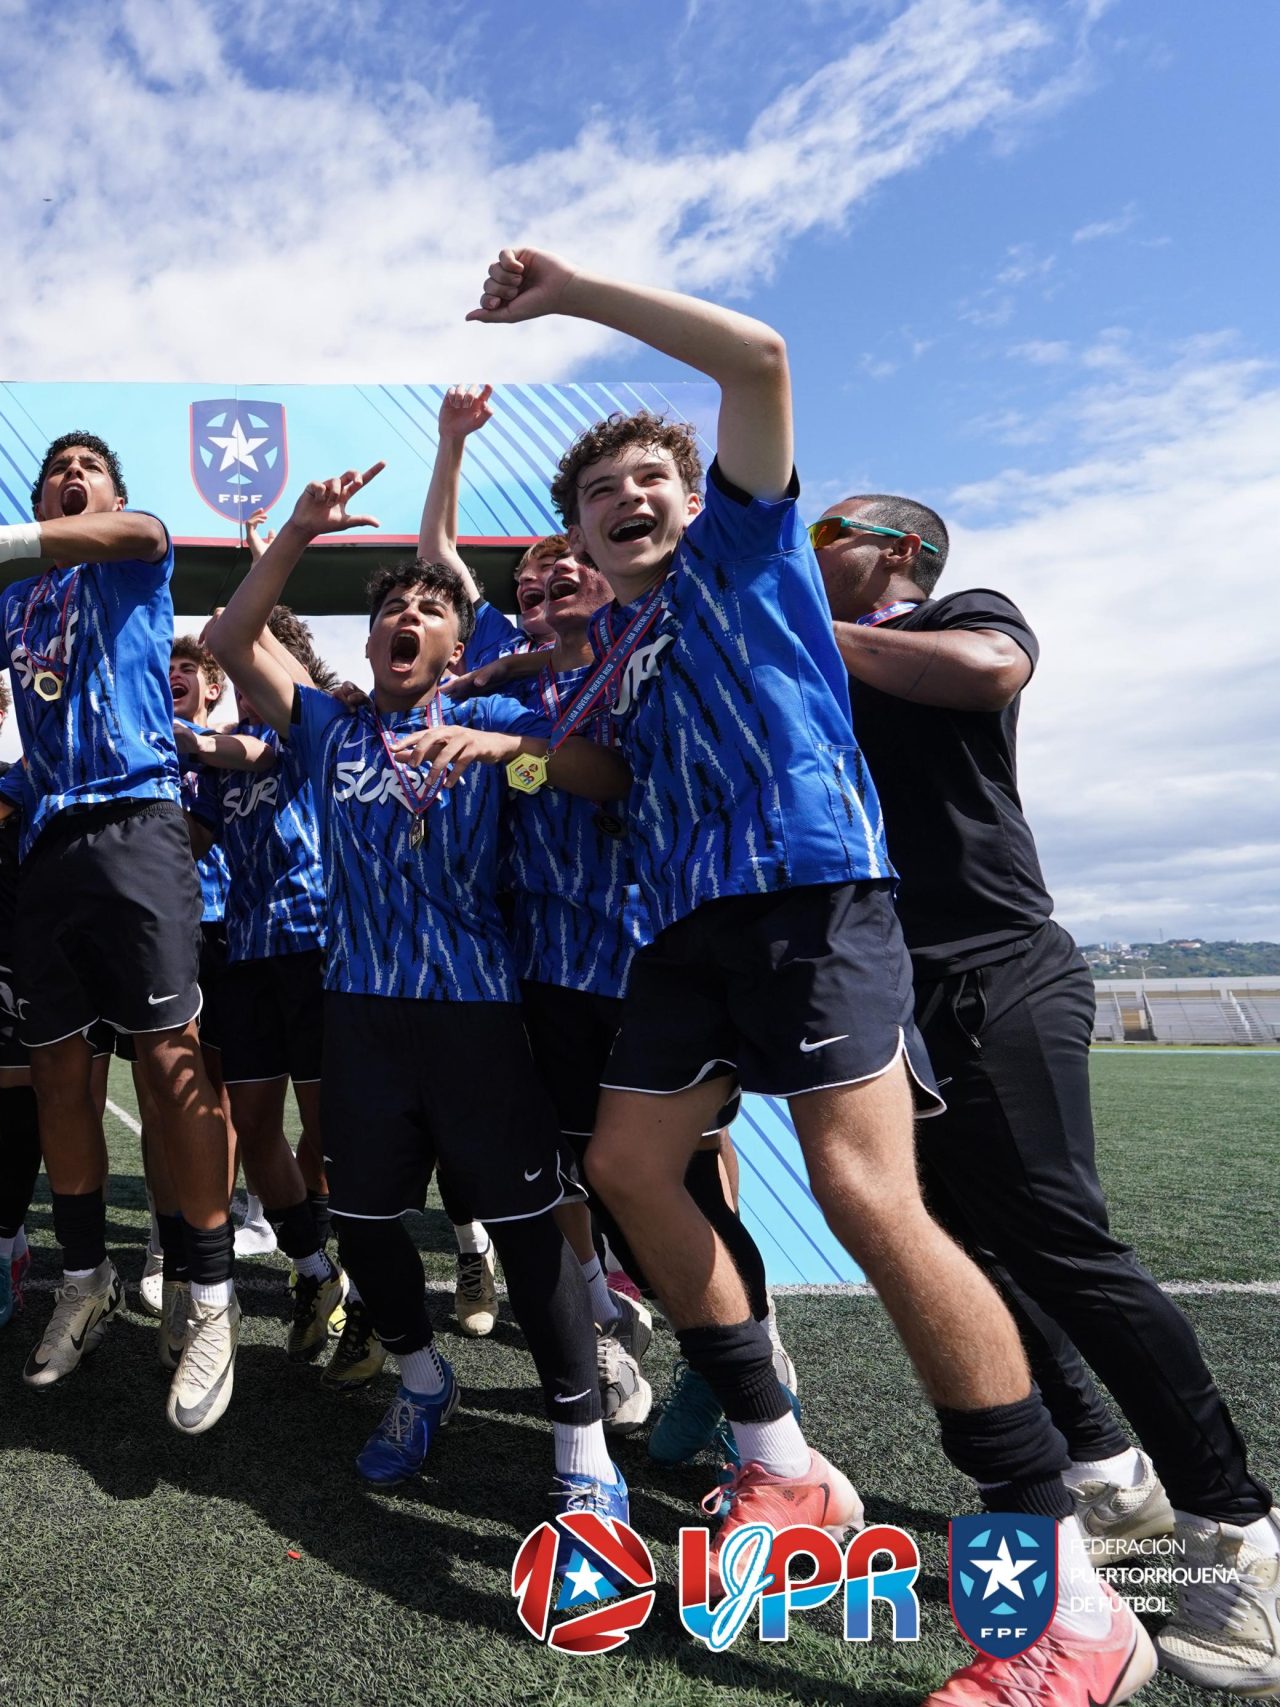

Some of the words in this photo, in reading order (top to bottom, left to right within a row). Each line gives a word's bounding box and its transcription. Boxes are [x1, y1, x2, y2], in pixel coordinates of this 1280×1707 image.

[218, 494, 263, 503] FPF
[568, 706, 579, 722] LIGA
[577, 690, 593, 711] JUVENIL
[589, 673, 607, 694] PUERTO
[602, 663, 614, 679] RICO
[223, 774, 281, 824] SUR
[333, 756, 438, 815] SUR
